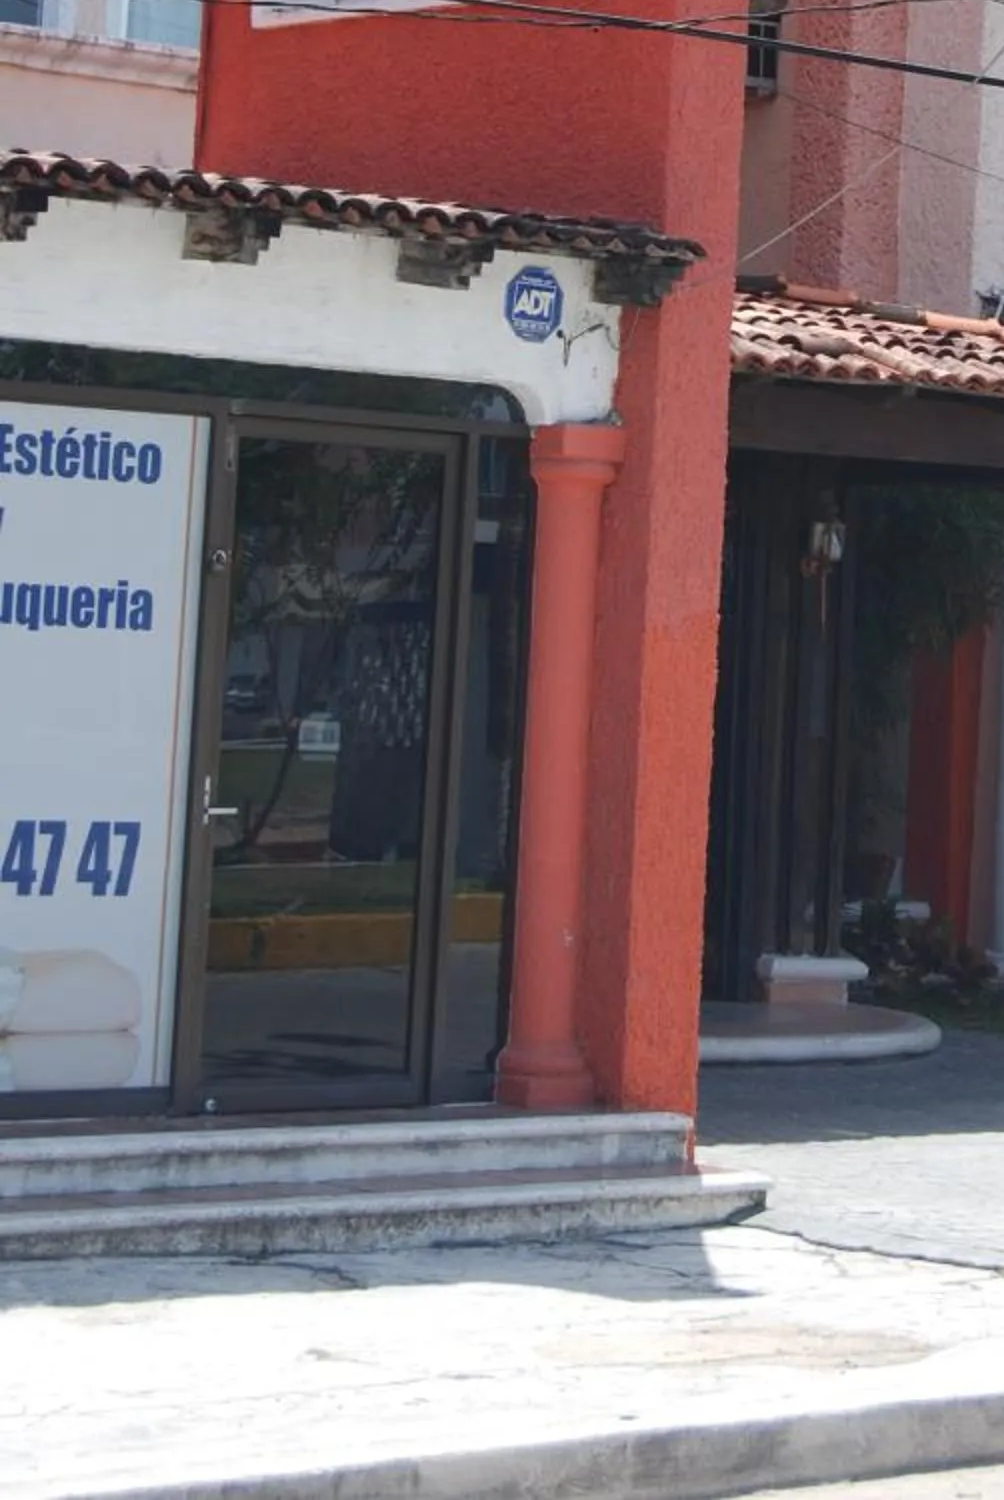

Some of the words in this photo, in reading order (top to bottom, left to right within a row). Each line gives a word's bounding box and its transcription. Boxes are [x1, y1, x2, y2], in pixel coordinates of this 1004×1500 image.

[513, 288, 554, 318] ADT
[0, 423, 162, 485] Estético
[0, 820, 67, 896] 47
[76, 821, 141, 896] 47
